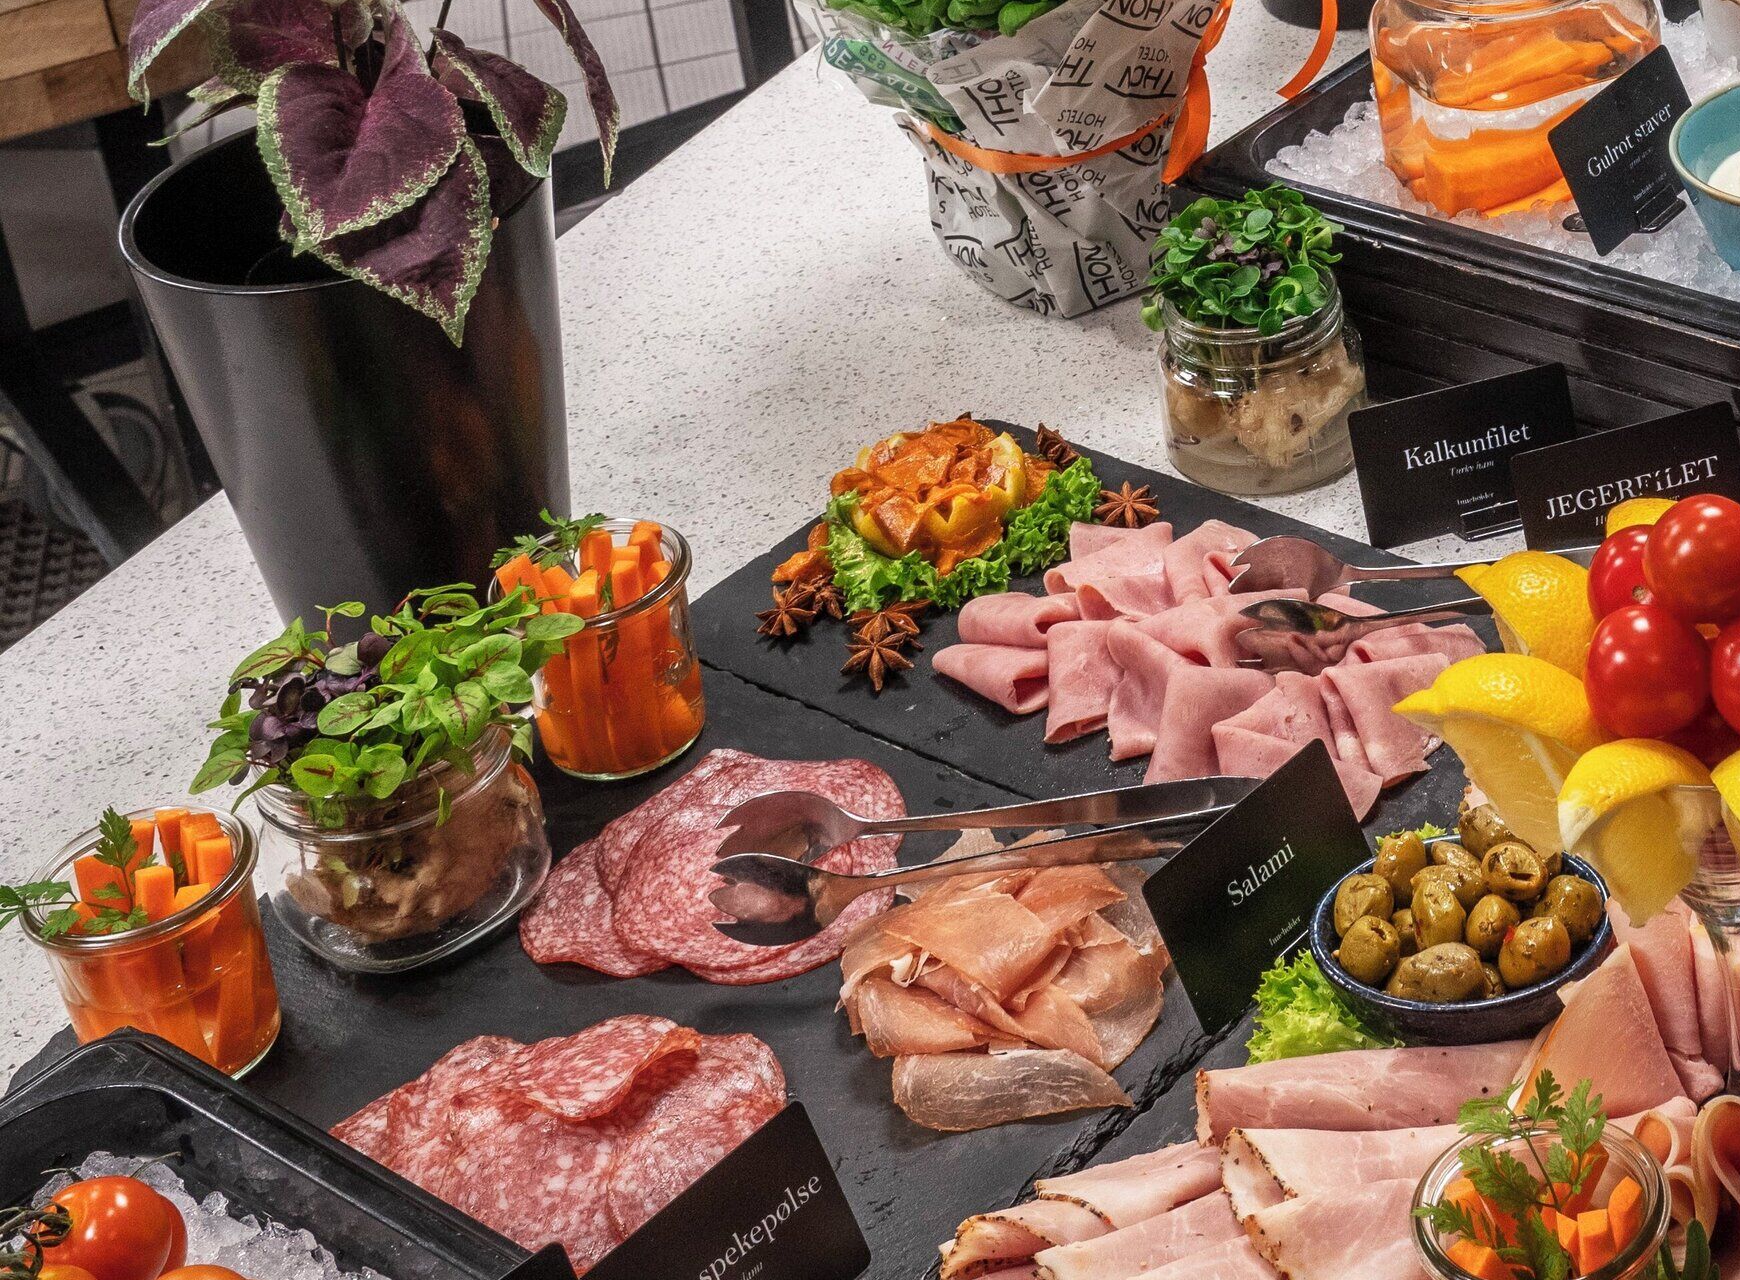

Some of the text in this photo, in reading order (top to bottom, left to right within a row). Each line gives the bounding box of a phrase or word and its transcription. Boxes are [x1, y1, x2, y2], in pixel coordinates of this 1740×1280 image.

[1587, 134, 1635, 178] Gulrot
[1633, 102, 1673, 143] staver
[1403, 422, 1532, 471] Kalkunfilet
[1226, 836, 1296, 907] Salami
